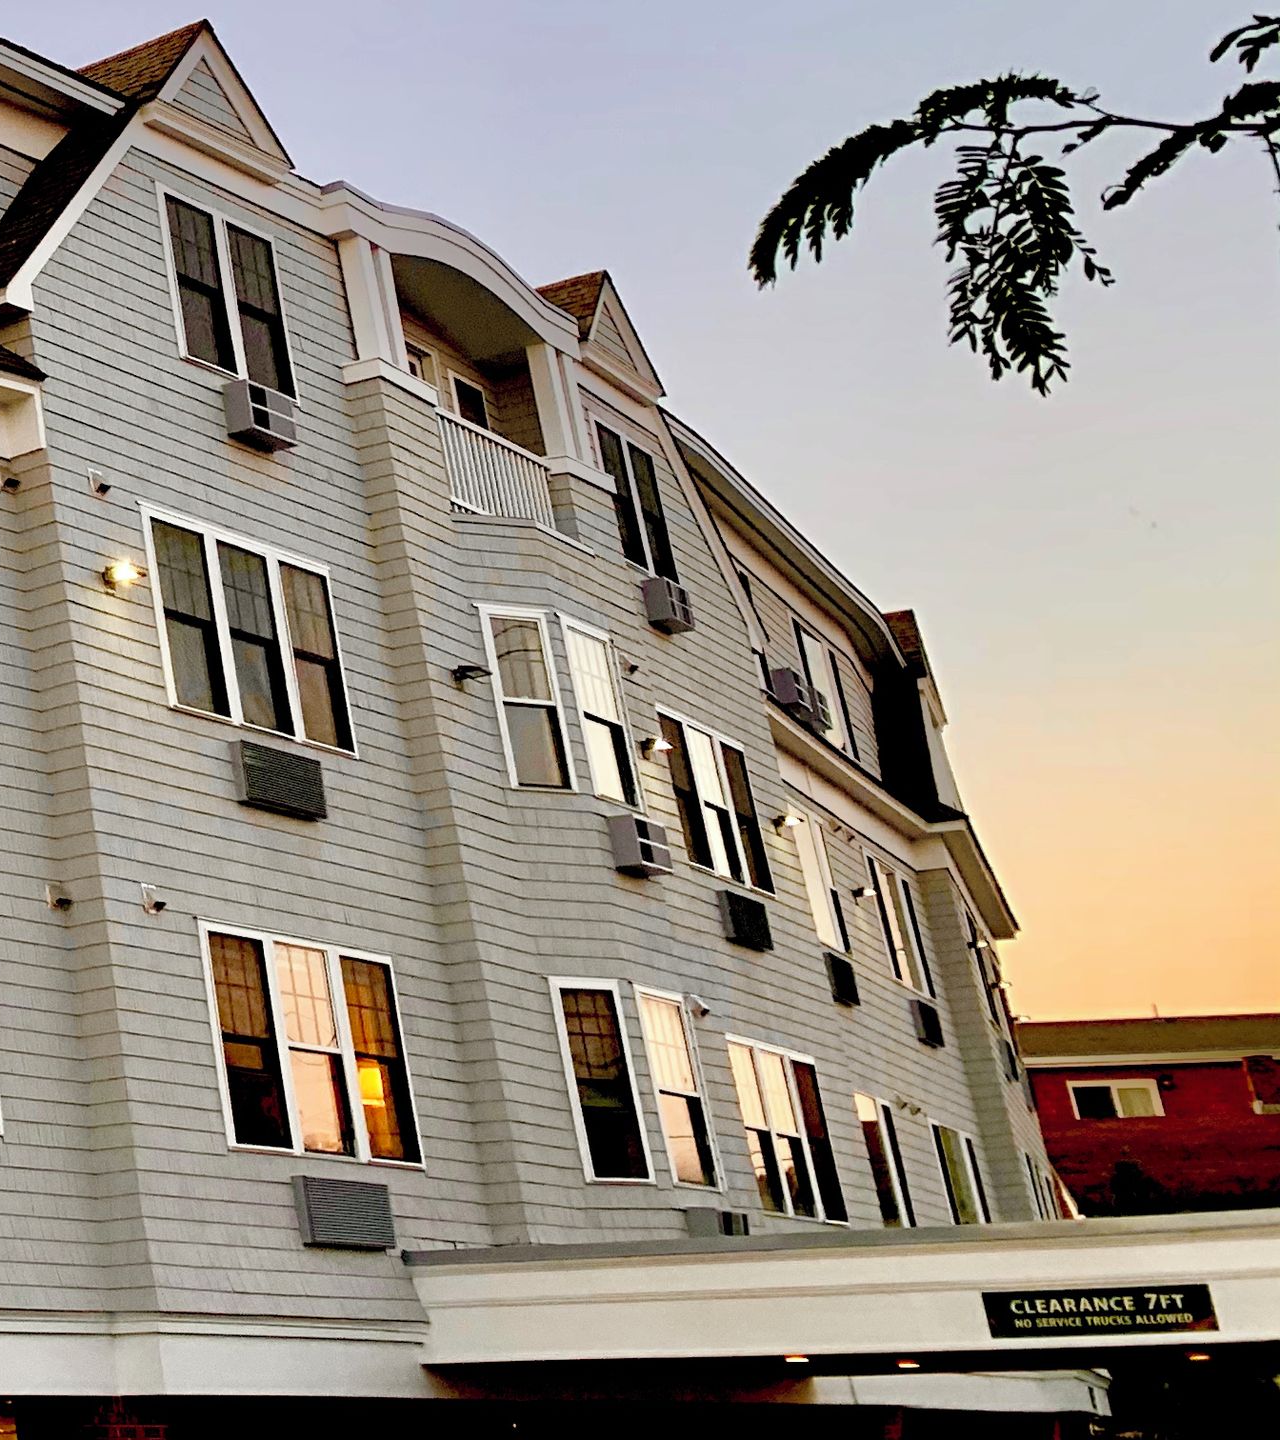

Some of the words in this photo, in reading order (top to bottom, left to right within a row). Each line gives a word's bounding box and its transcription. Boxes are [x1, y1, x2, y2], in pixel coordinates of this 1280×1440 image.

[1010, 1296, 1135, 1314] CLEARANCE
[1143, 1293, 1184, 1310] 7FT
[1014, 1318, 1032, 1329] NO
[1036, 1316, 1082, 1328] SERVICE
[1085, 1315, 1132, 1326] TRUCKS
[1136, 1313, 1193, 1324] ALLOWED
